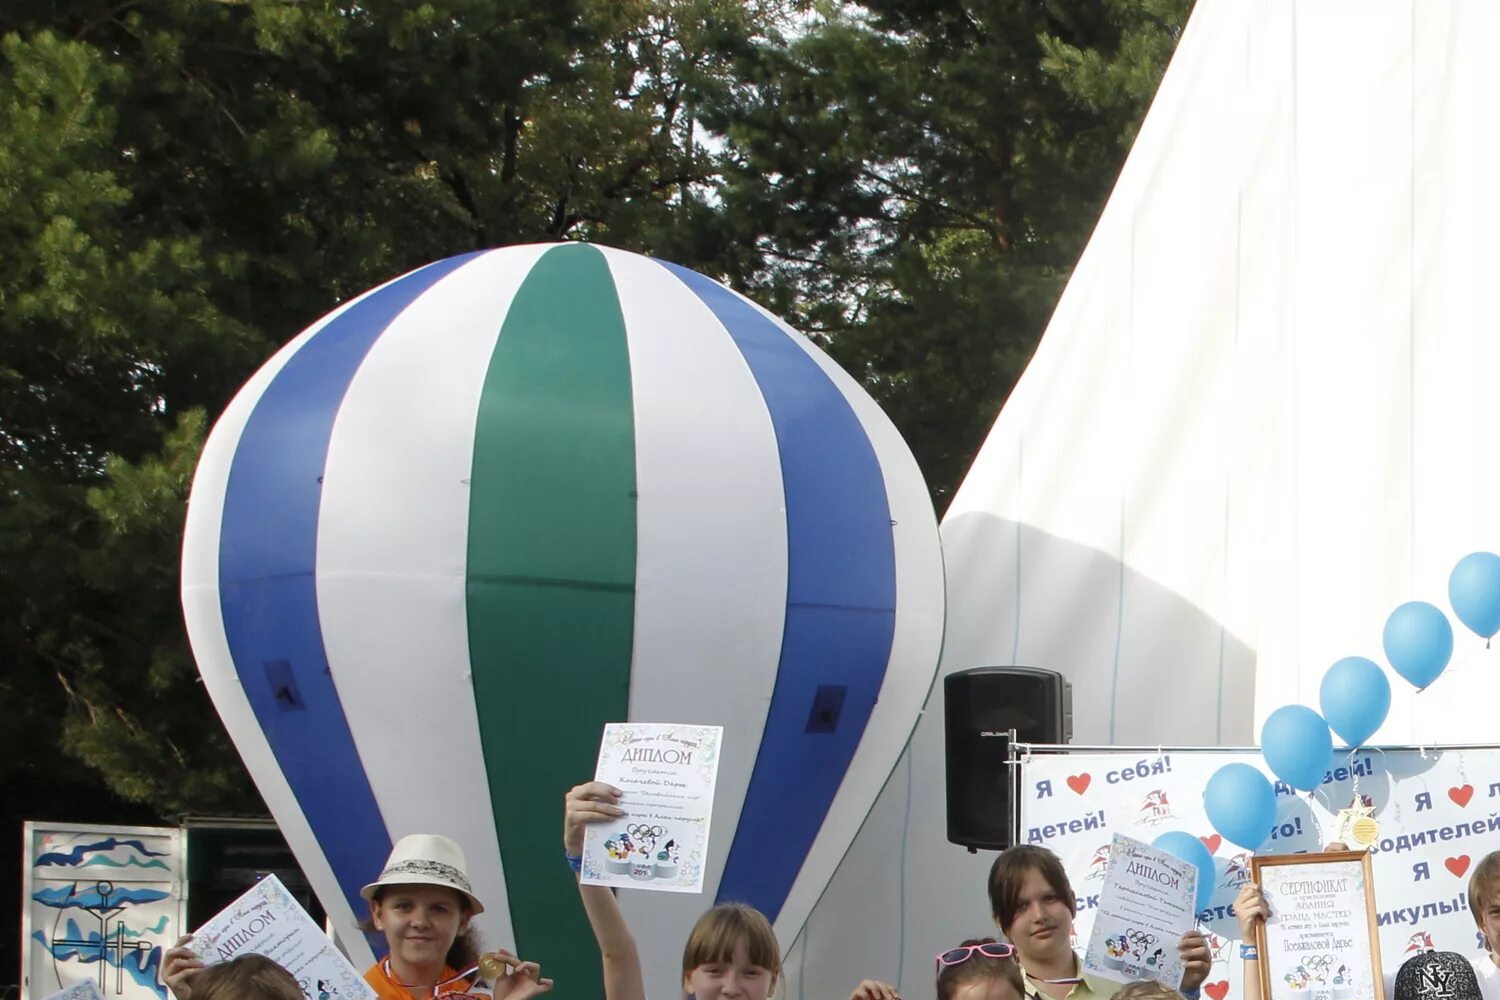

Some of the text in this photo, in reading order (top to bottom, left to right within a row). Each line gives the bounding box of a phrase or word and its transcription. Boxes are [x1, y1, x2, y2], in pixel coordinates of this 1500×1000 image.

[621, 748, 692, 765] ДИПЛОМ
[1036, 755, 1172, 798] Я себя!
[1414, 792, 1432, 811] Я
[1027, 811, 1106, 843] детей!
[1126, 861, 1180, 890] ДИПЛОМ
[1412, 863, 1430, 881] Я
[1280, 879, 1347, 896] СЕРТИФИКАТ
[1377, 893, 1467, 926] икулы!
[216, 910, 276, 961] ДИПЛОМ
[1415, 964, 1454, 997] NY
